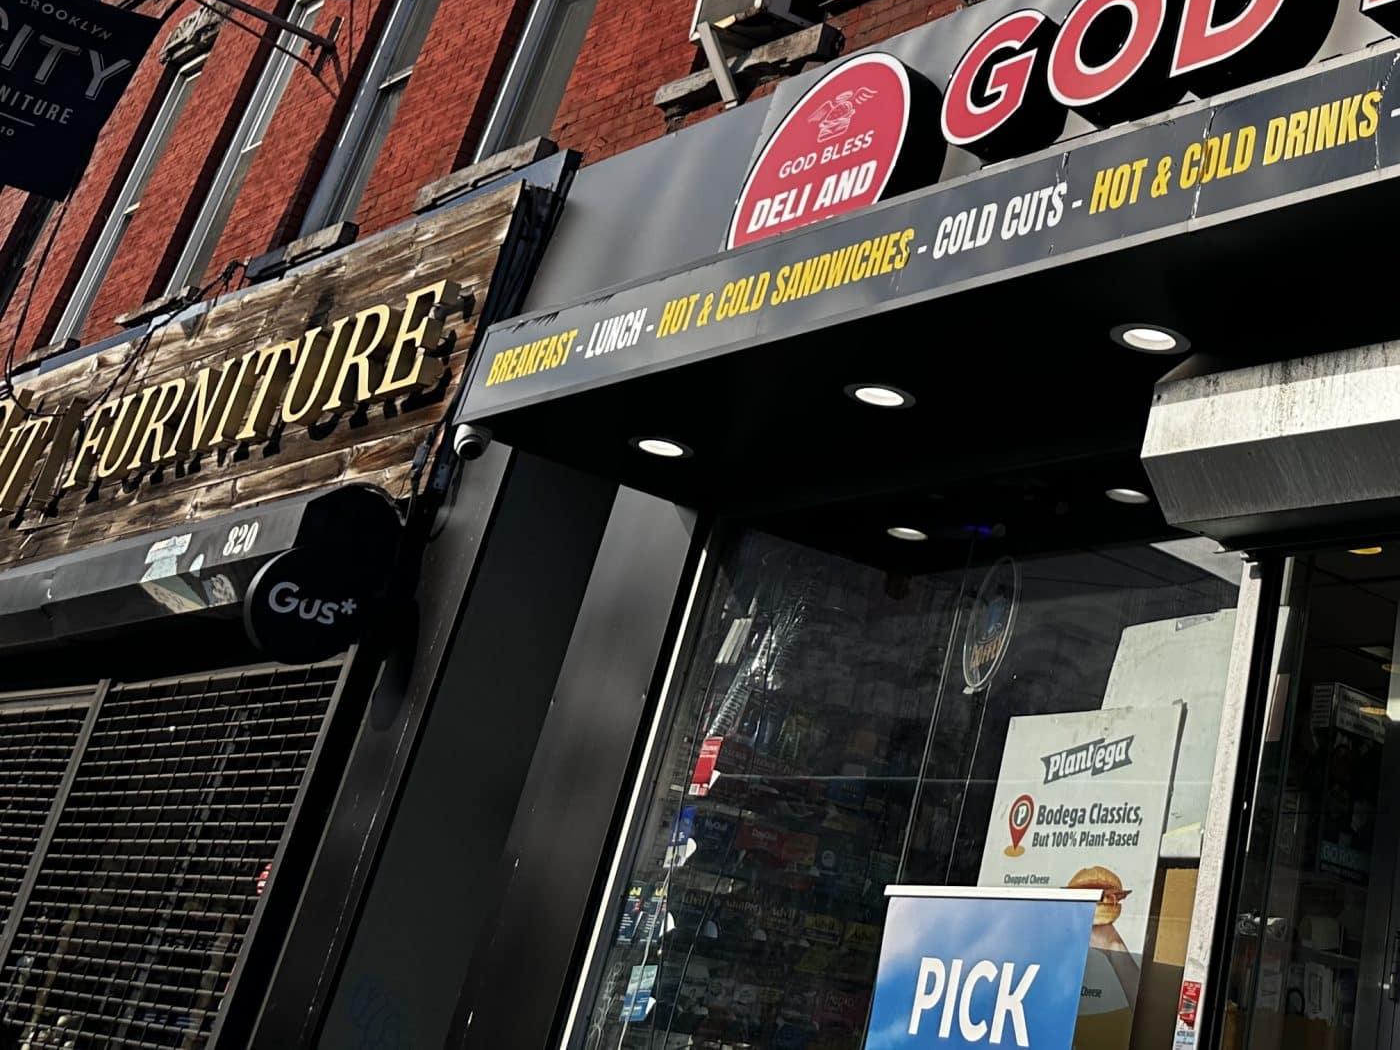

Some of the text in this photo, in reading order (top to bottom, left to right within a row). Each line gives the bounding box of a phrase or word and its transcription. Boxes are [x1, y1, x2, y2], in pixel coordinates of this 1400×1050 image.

[0, 6, 131, 100] ITY
[779, 130, 874, 179] GOD BLESS
[746, 160, 878, 234] DELI AND
[485, 329, 579, 387] BREAKFAST
[585, 307, 648, 358] LUNCH
[656, 292, 701, 338] HOT
[697, 293, 712, 326] &
[715, 271, 772, 323] COLD
[770, 228, 915, 304] SANDWICHES
[933, 198, 996, 259] COLD
[1001, 182, 1067, 241] CUTS
[1089, 160, 1148, 214] HOT
[1150, 155, 1171, 199] &
[1179, 125, 1257, 190] COLD
[1263, 88, 1382, 166] DRINKS
[62, 279, 452, 488] FURNITURE
[222, 521, 260, 557] 820
[1047, 740, 1128, 781] Plantega
[1032, 830, 1140, 847] But 100% Plant-Based
[1036, 802, 1143, 828] Bodega Classics,
[1004, 874, 1050, 885] Chopped Cheese
[908, 957, 1041, 1047] PICK
